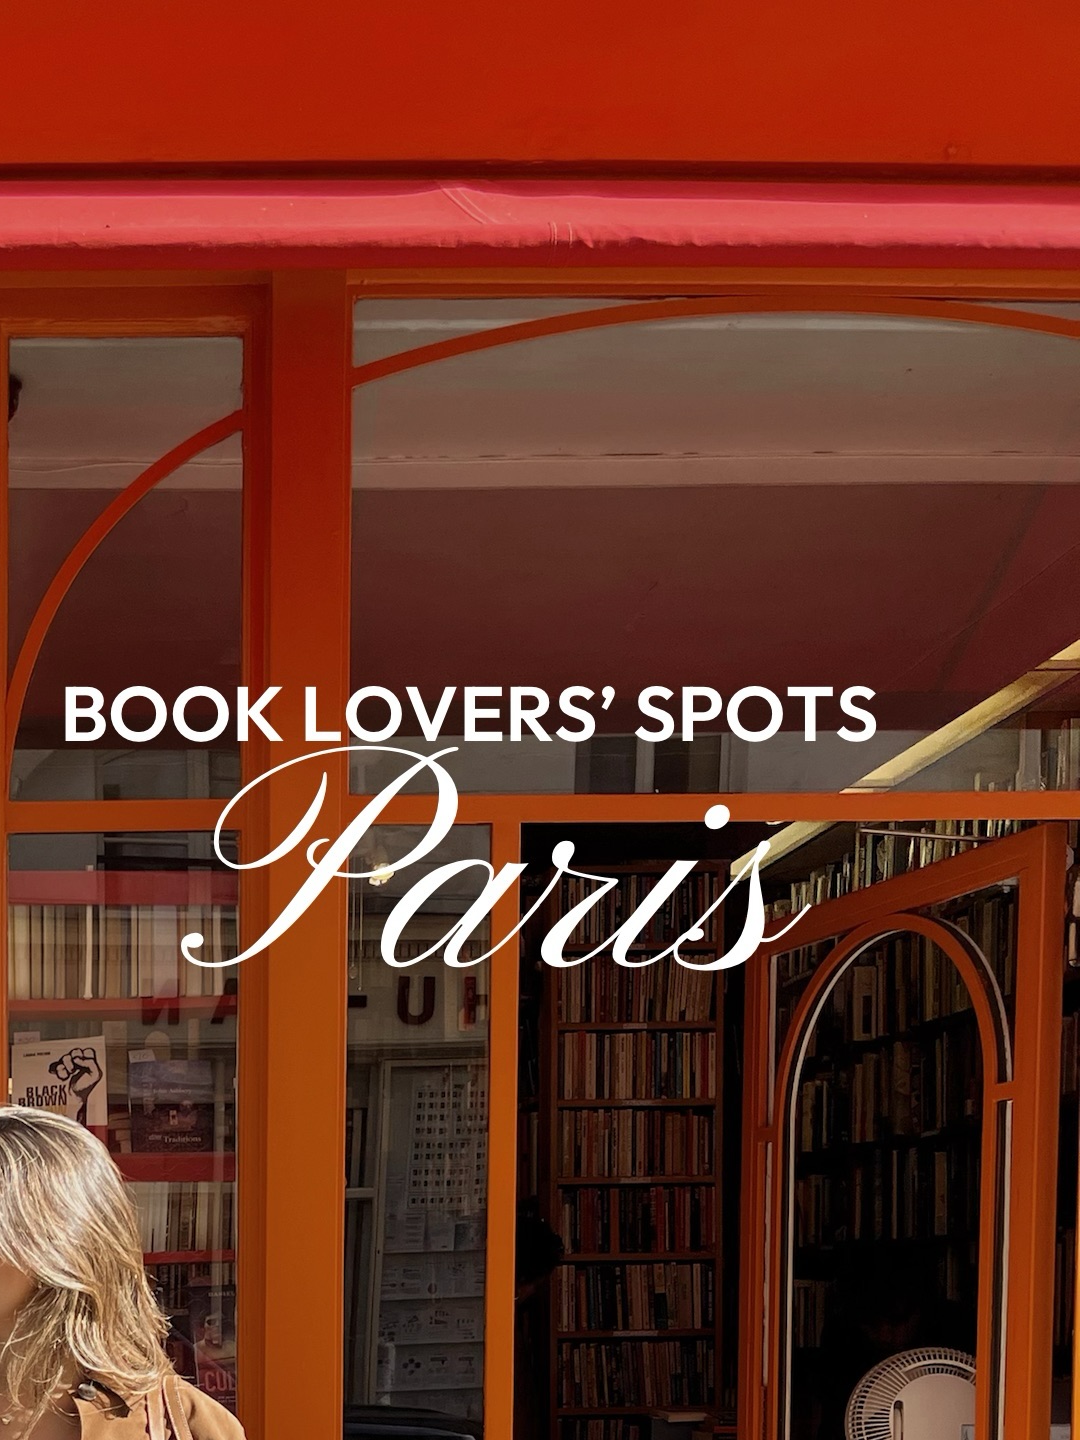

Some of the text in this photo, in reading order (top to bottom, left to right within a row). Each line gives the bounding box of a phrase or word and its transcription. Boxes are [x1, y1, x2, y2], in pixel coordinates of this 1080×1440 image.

[26, 1085, 67, 1098] BLACK
[18, 1095, 67, 1107] BROWN
[163, 1134, 202, 1144] Traditions
